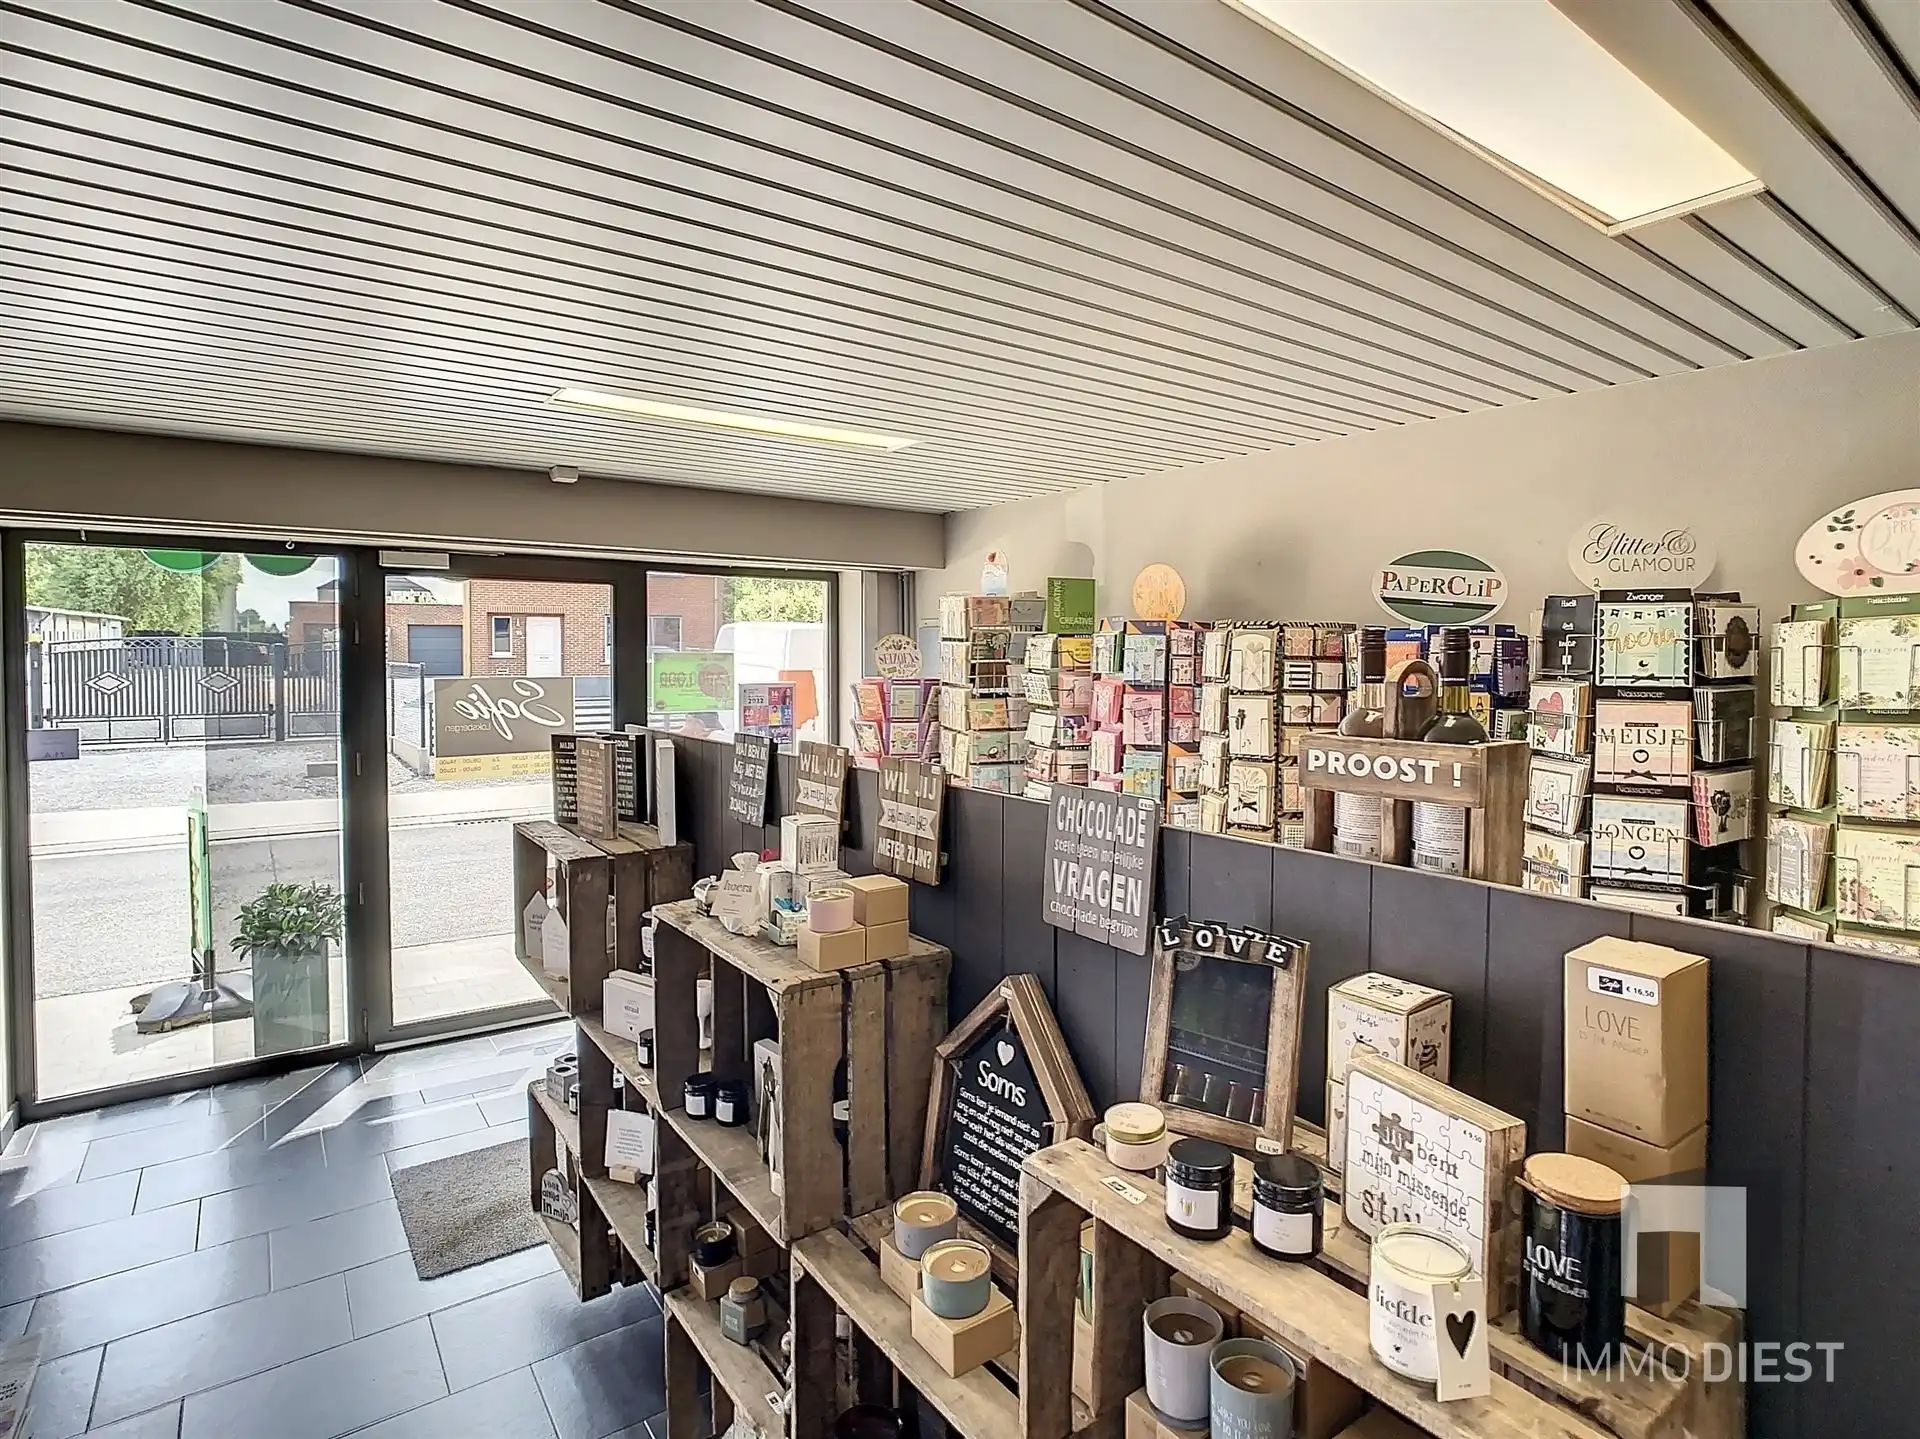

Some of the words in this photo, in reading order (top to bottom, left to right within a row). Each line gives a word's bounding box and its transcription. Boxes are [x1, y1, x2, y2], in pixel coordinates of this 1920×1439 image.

[1582, 523, 1665, 564] Glitter
[1608, 557, 1696, 573] GLAMOUR
[1626, 592, 1664, 602] Zwanger
[1059, 616, 1093, 625] CREATIVE
[1599, 727, 1685, 746] MEISJE
[800, 752, 820, 775] WIL
[823, 757, 841, 779] JIJ
[1307, 748, 1441, 785] PROOST
[883, 768, 910, 795] WIL
[914, 774, 938, 801] JIJ
[1056, 795, 1147, 849] CHOCOLADE
[1595, 823, 1681, 844] JONGEN
[877, 836, 906, 862] METER
[1052, 857, 1143, 918] VRAGEN
[1098, 912, 1139, 939] begrijpt
[1584, 1005, 1642, 1042] LOVE
[977, 1060, 1027, 1107] Soms
[1416, 1142, 1459, 1180] bent
[1361, 1149, 1393, 1178] mijn
[1397, 1169, 1467, 1222] missende
[553, 1207, 570, 1223] mijn
[1526, 1235, 1583, 1284] LOVE
[1375, 1284, 1433, 1328] liefde
